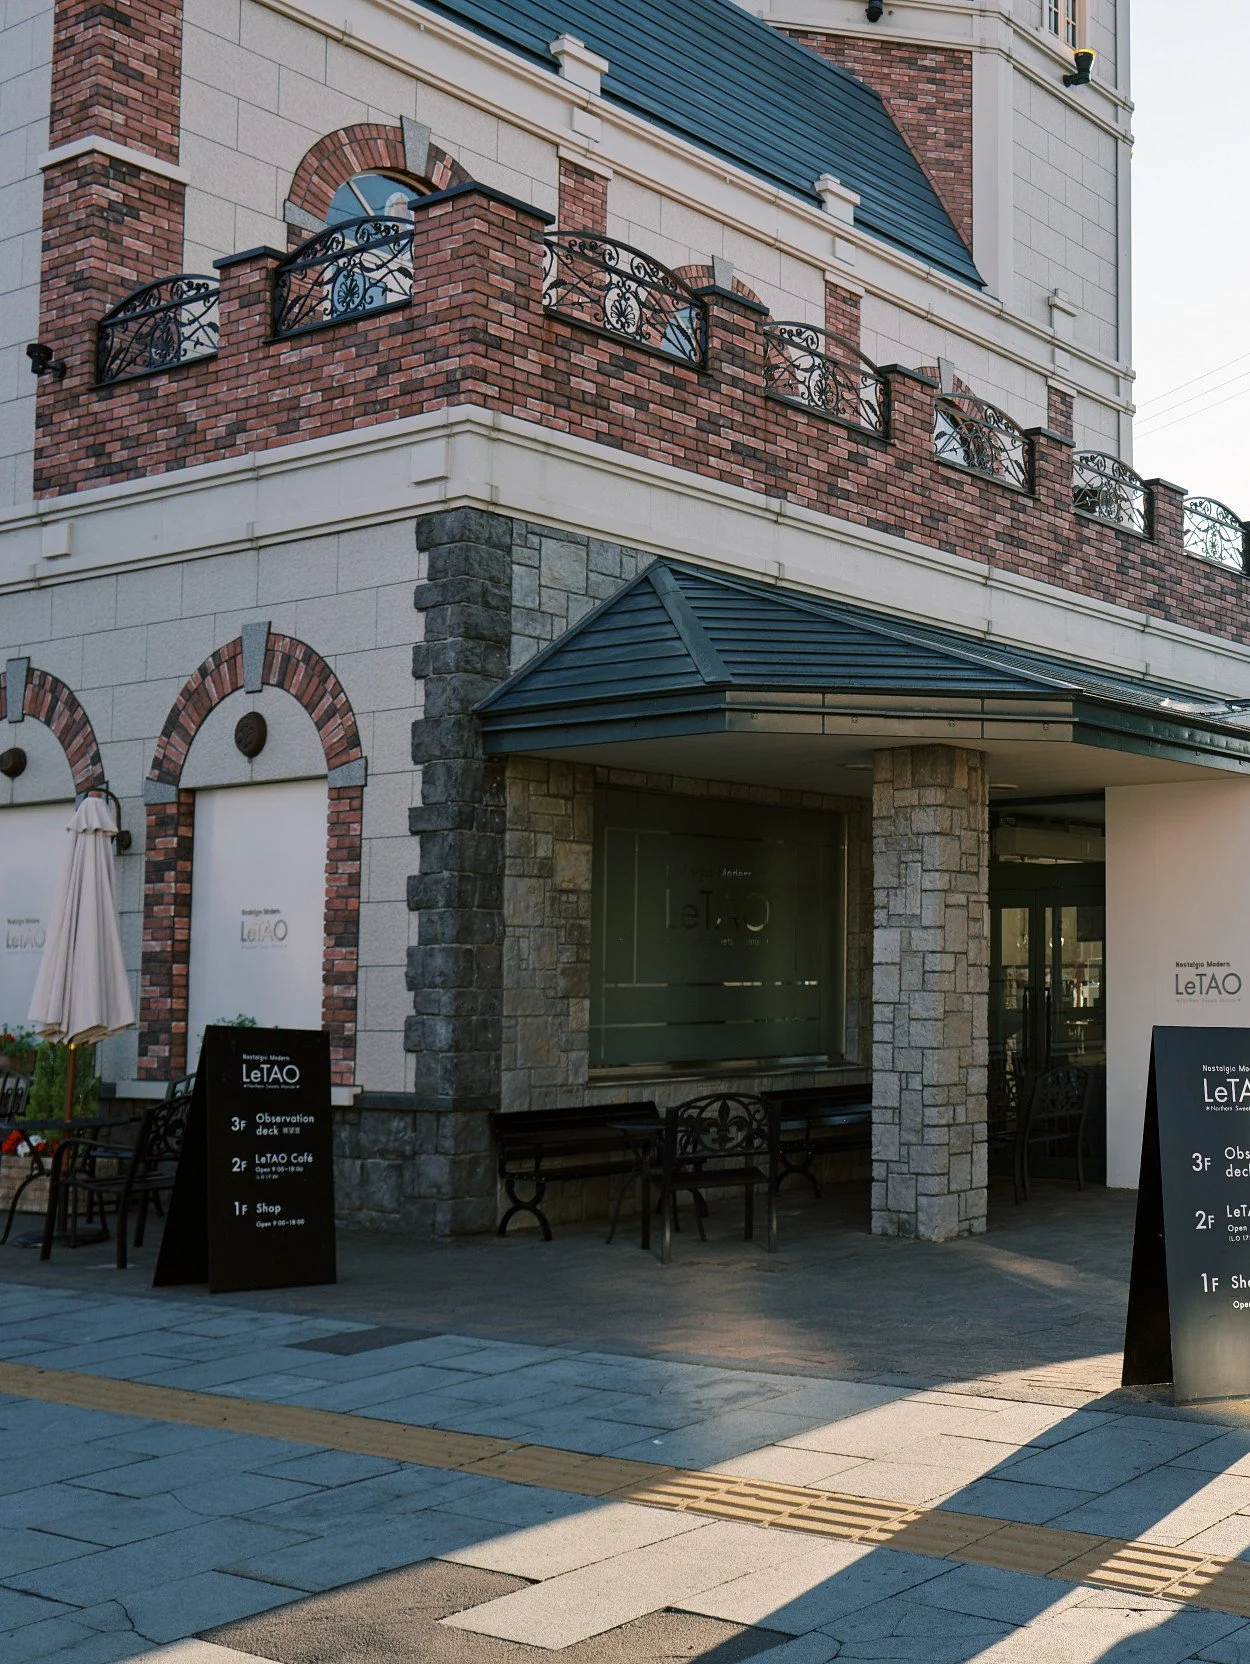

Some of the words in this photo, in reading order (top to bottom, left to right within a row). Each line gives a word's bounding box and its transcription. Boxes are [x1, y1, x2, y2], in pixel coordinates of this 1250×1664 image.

[241, 919, 288, 942] LeTAO
[1175, 972, 1242, 995] LeTAO
[242, 1063, 300, 1083] LeTAO
[1202, 1065, 1236, 1074] Nostalgic
[231, 1116, 247, 1131] 3F
[255, 1112, 315, 1123] Observation
[256, 1125, 279, 1135] deck
[231, 1157, 248, 1172] 2F
[255, 1153, 288, 1164] LeTAO
[290, 1152, 313, 1163] Café
[1191, 1152, 1212, 1172] 3F
[234, 1201, 248, 1216] 1F
[256, 1202, 281, 1215] Shop
[1195, 1210, 1215, 1230] 2F
[1227, 1223, 1248, 1233] Open
[1200, 1273, 1219, 1293] 1F
